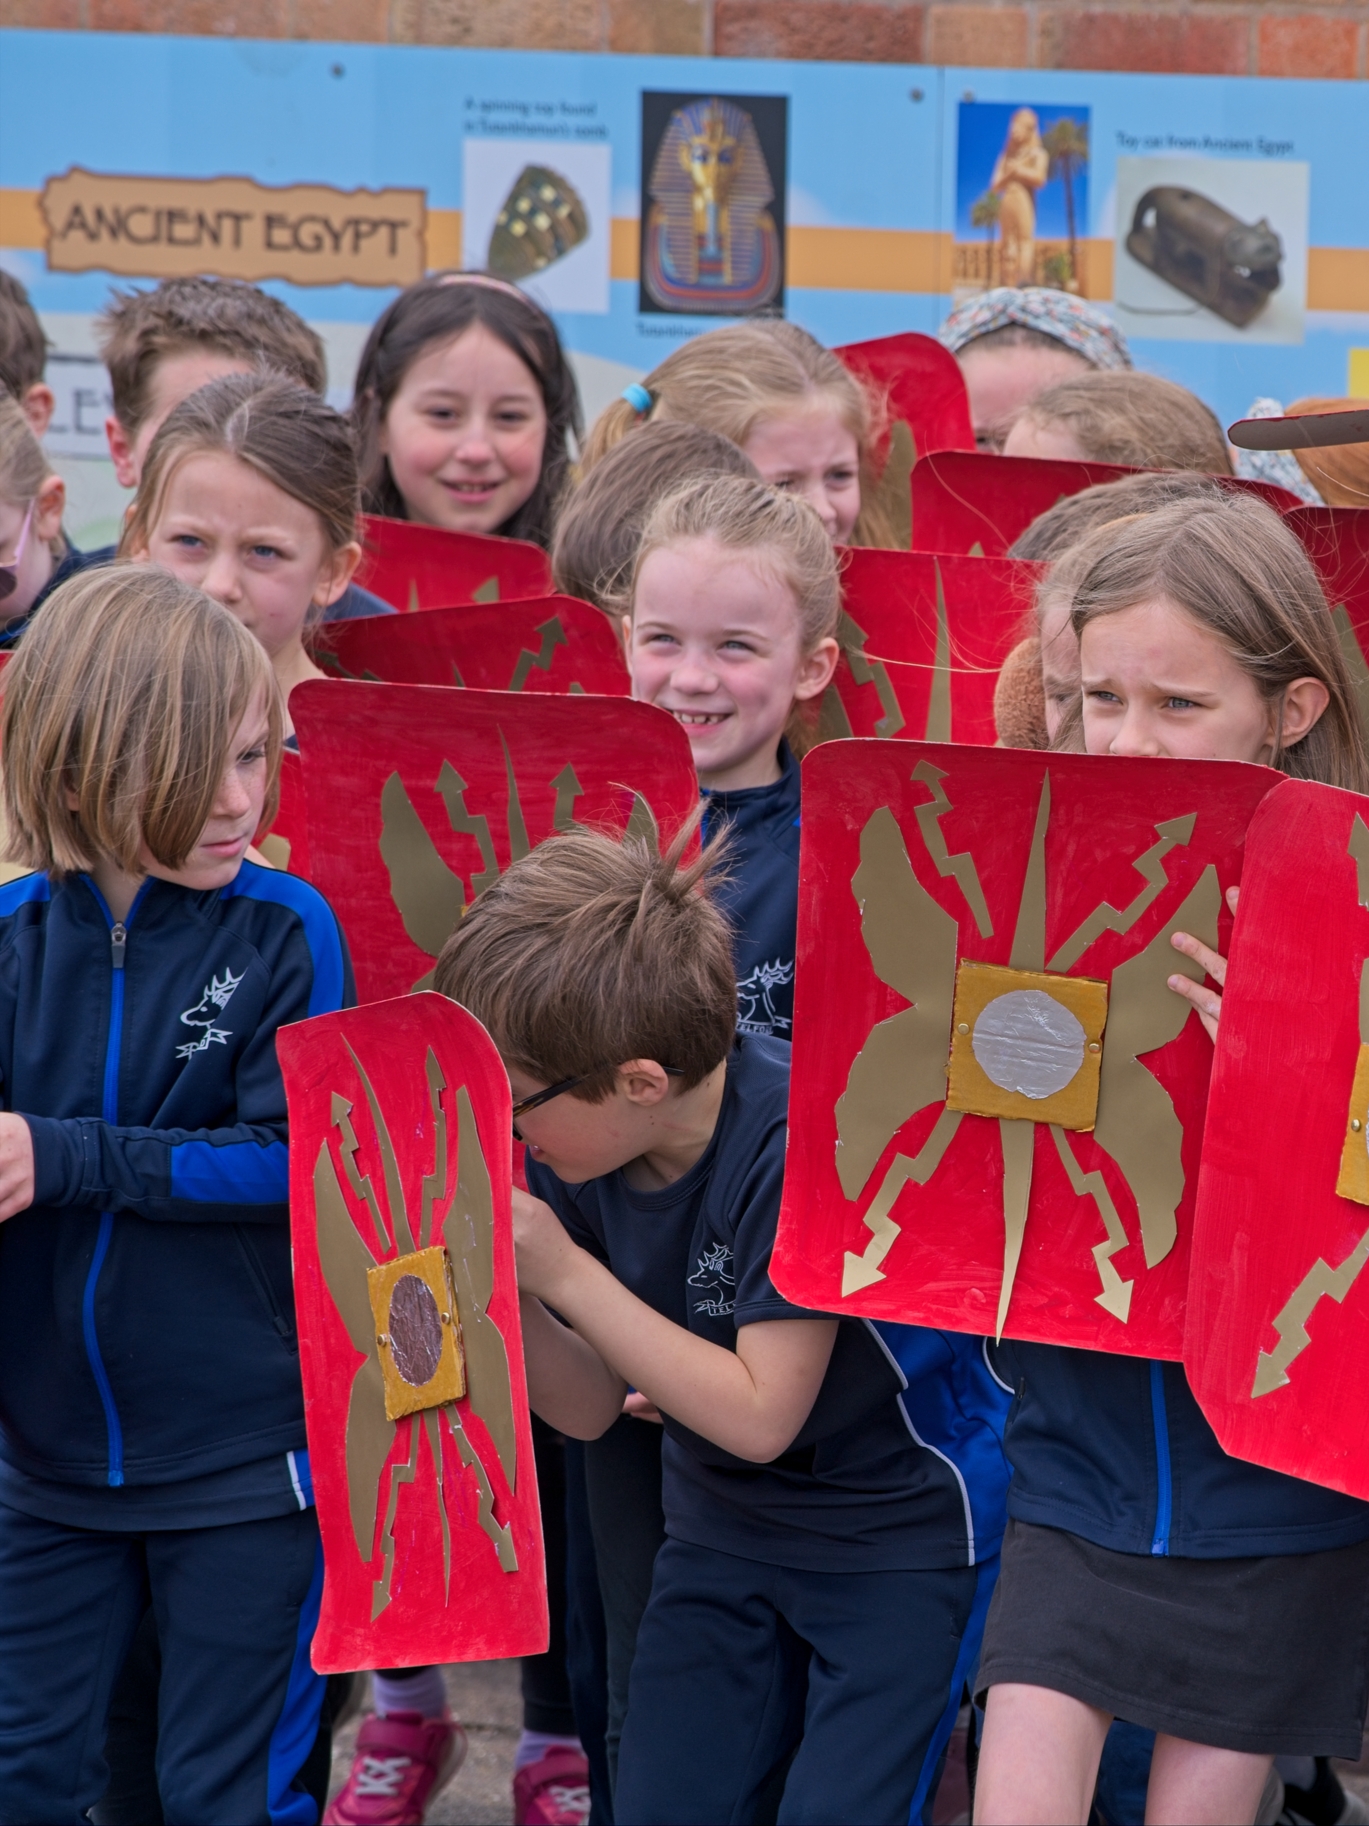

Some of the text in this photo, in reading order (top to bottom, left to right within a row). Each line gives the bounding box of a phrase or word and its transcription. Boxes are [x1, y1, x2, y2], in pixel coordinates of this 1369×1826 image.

[1202, 134, 1254, 151] Ancient
[1256, 135, 1294, 156] Egypt
[59, 203, 409, 258] ANCIENT EGYPT
